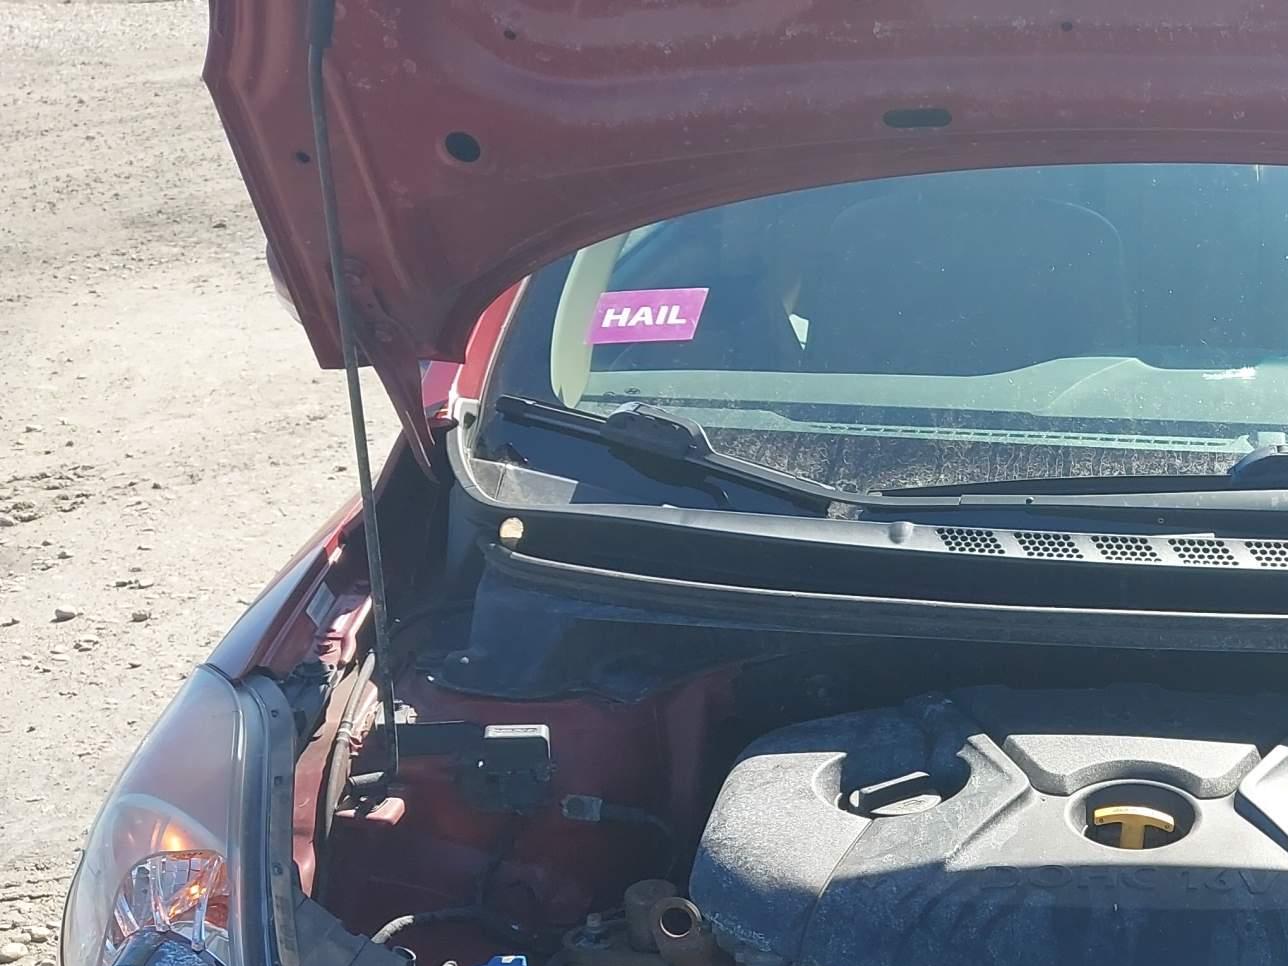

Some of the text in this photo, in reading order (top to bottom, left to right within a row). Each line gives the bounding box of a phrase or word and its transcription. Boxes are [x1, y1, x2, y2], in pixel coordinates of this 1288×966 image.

[601, 305, 687, 328] HAIL
[980, 865, 1282, 895] DOHC 16V
